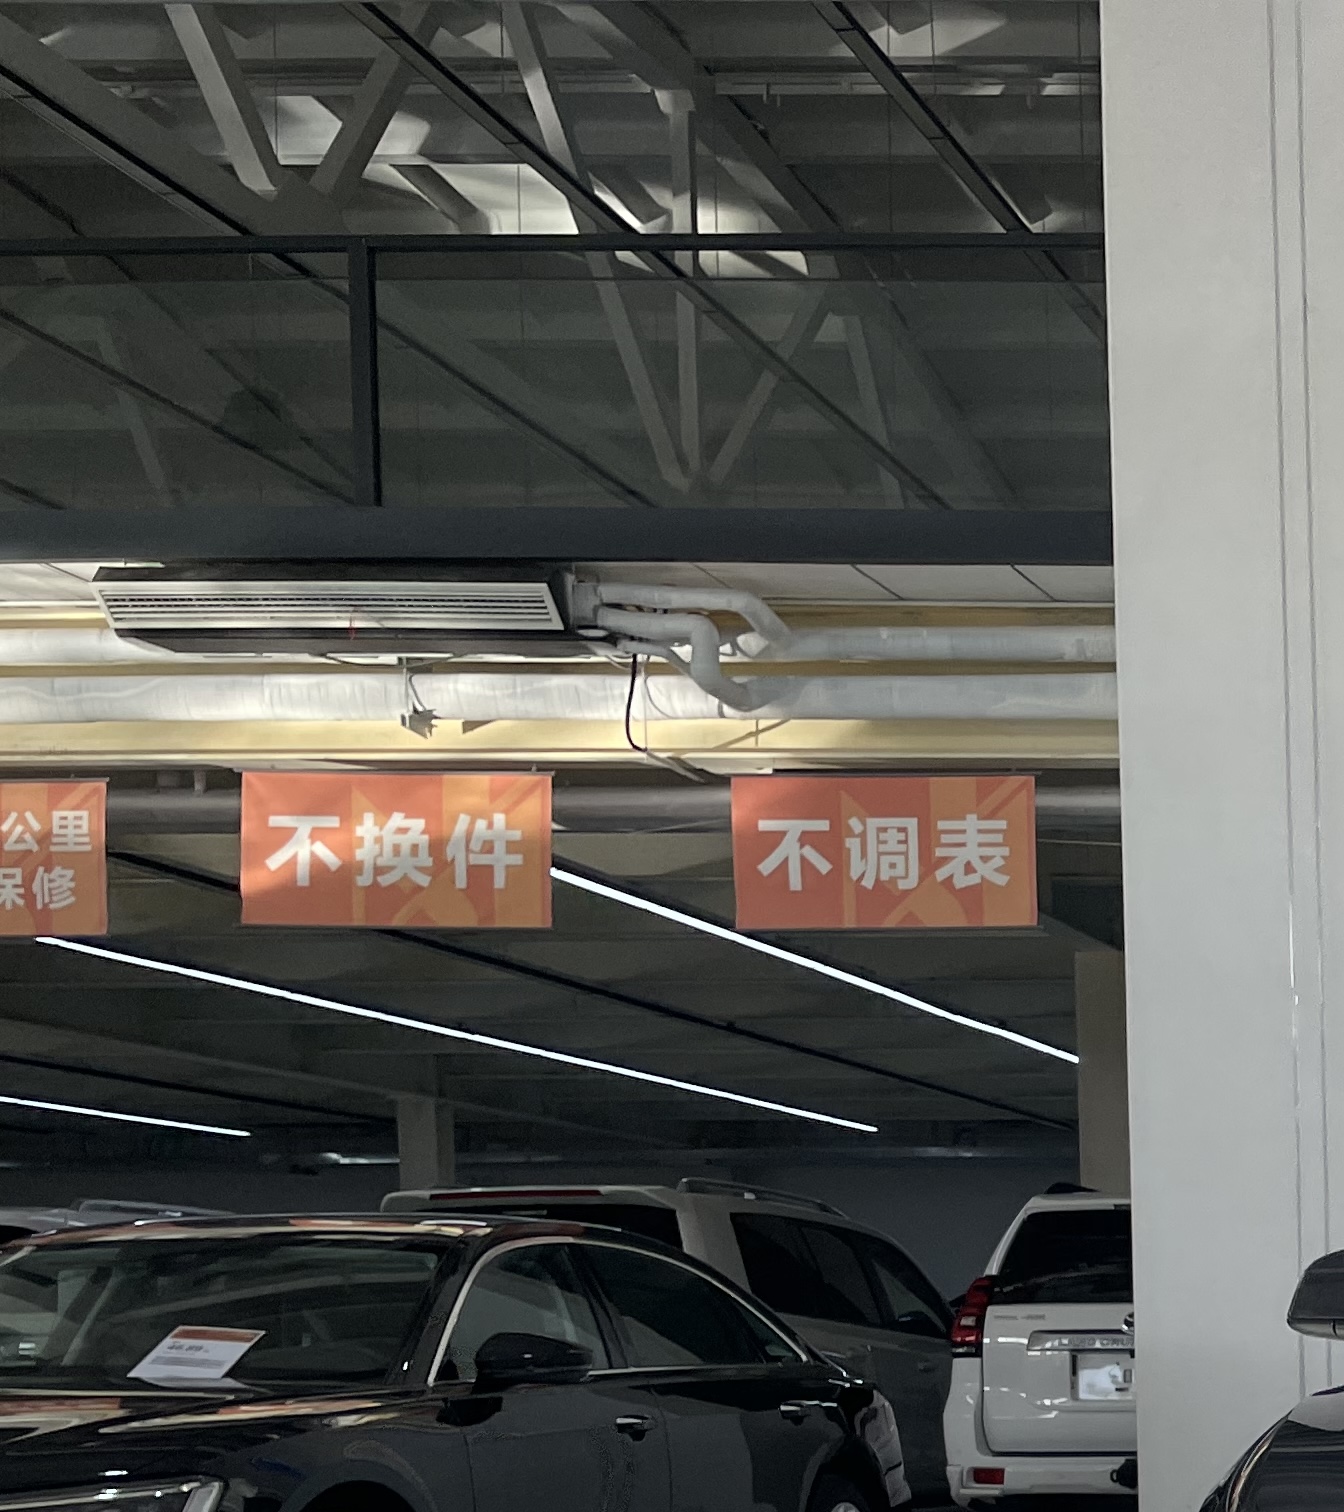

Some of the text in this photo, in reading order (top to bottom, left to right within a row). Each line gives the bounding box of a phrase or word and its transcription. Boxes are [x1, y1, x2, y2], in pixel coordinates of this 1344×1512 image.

[1, 811, 92, 852] 公里
[265, 812, 523, 889] 不换件
[757, 814, 1010, 892] 不调表
